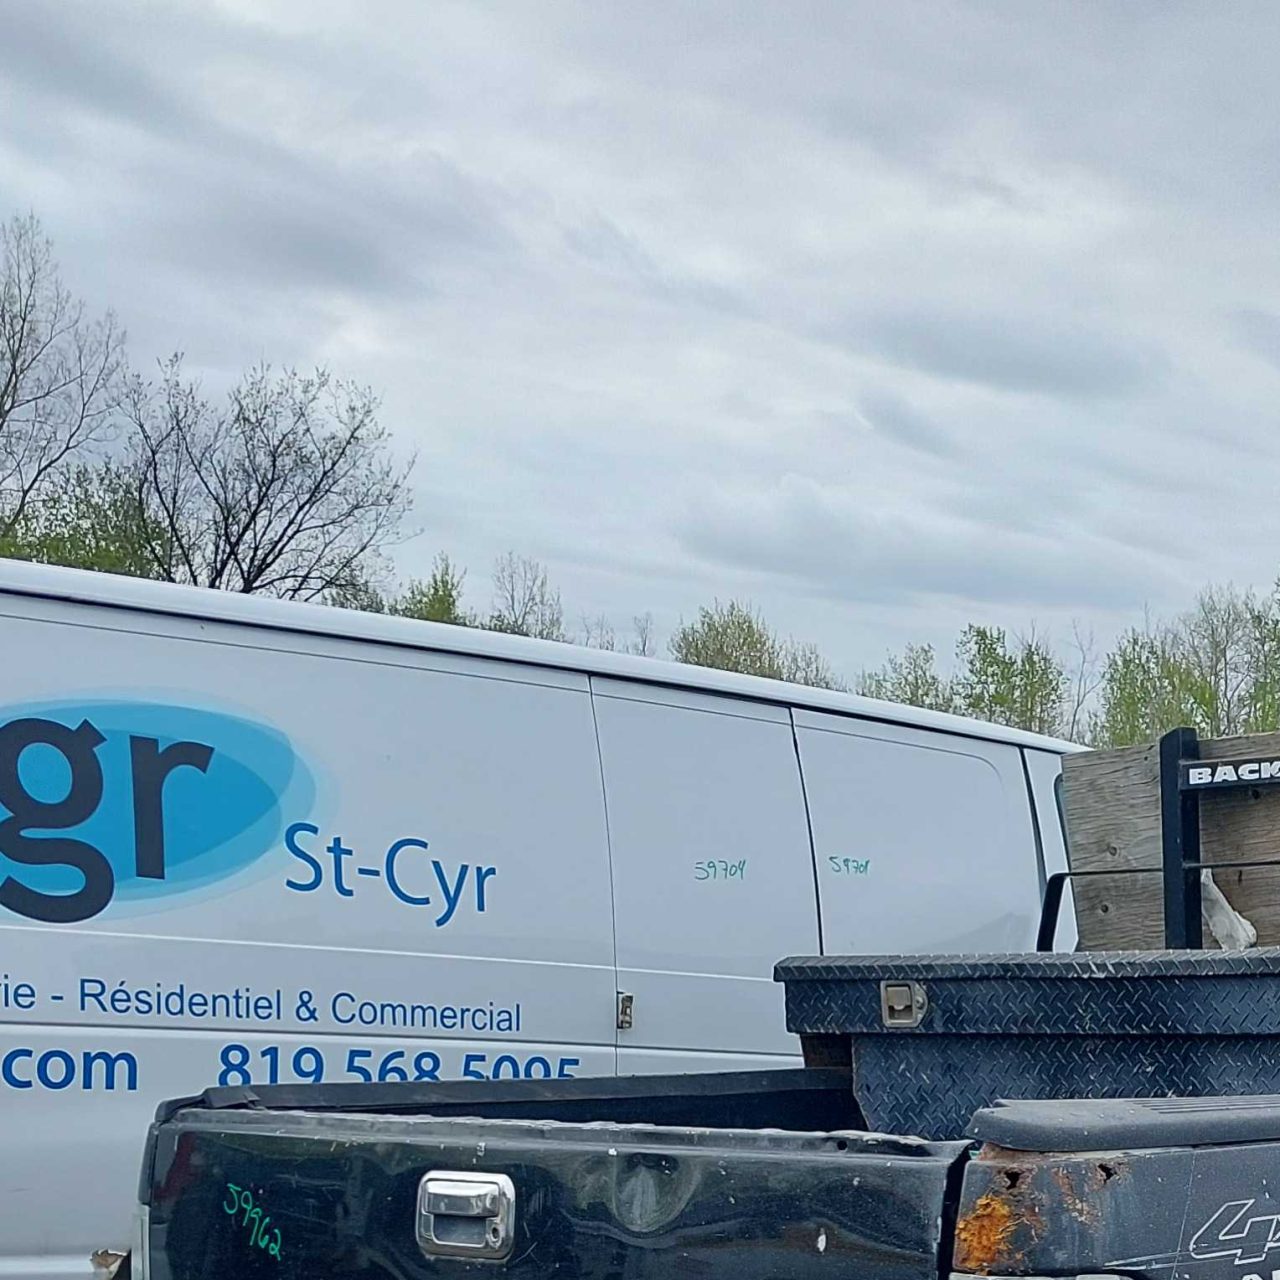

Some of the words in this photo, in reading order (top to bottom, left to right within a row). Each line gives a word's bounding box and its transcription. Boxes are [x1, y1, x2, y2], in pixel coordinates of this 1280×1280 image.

[284, 822, 497, 928] St-Cyr
[694, 860, 747, 881] 59704
[0, 973, 36, 1010] ie
[79, 978, 282, 1022] Résidentiel
[295, 990, 318, 1021] &
[331, 991, 521, 1033] Commercial
[2, 1047, 138, 1091] com
[217, 1044, 324, 1087] 819
[224, 1183, 282, 1261] 59962
